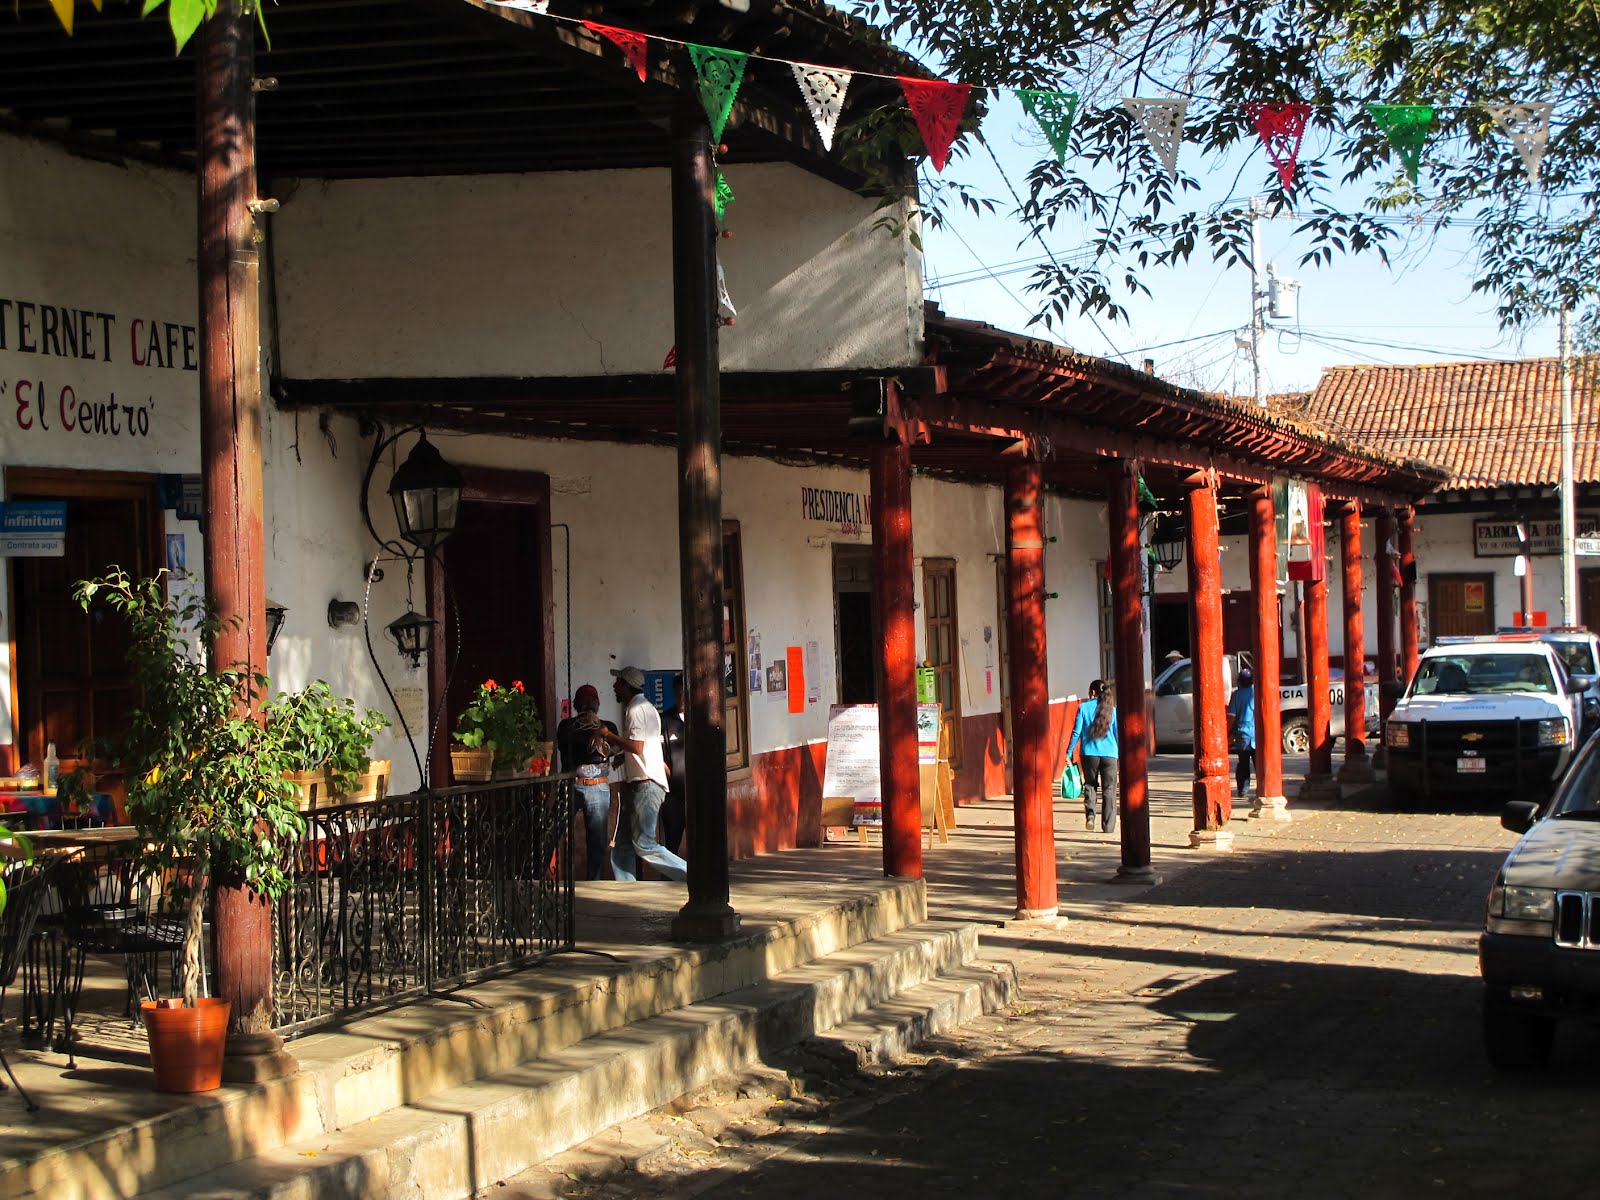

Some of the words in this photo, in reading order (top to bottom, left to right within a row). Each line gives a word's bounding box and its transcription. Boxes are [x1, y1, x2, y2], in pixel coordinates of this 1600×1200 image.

[131, 318, 198, 371] CAFE
[801, 487, 862, 525] PRESIDENCIA
[4, 515, 63, 527] infinitum
[1479, 524, 1539, 538] FARMAA
[7, 541, 40, 550] Contrata
